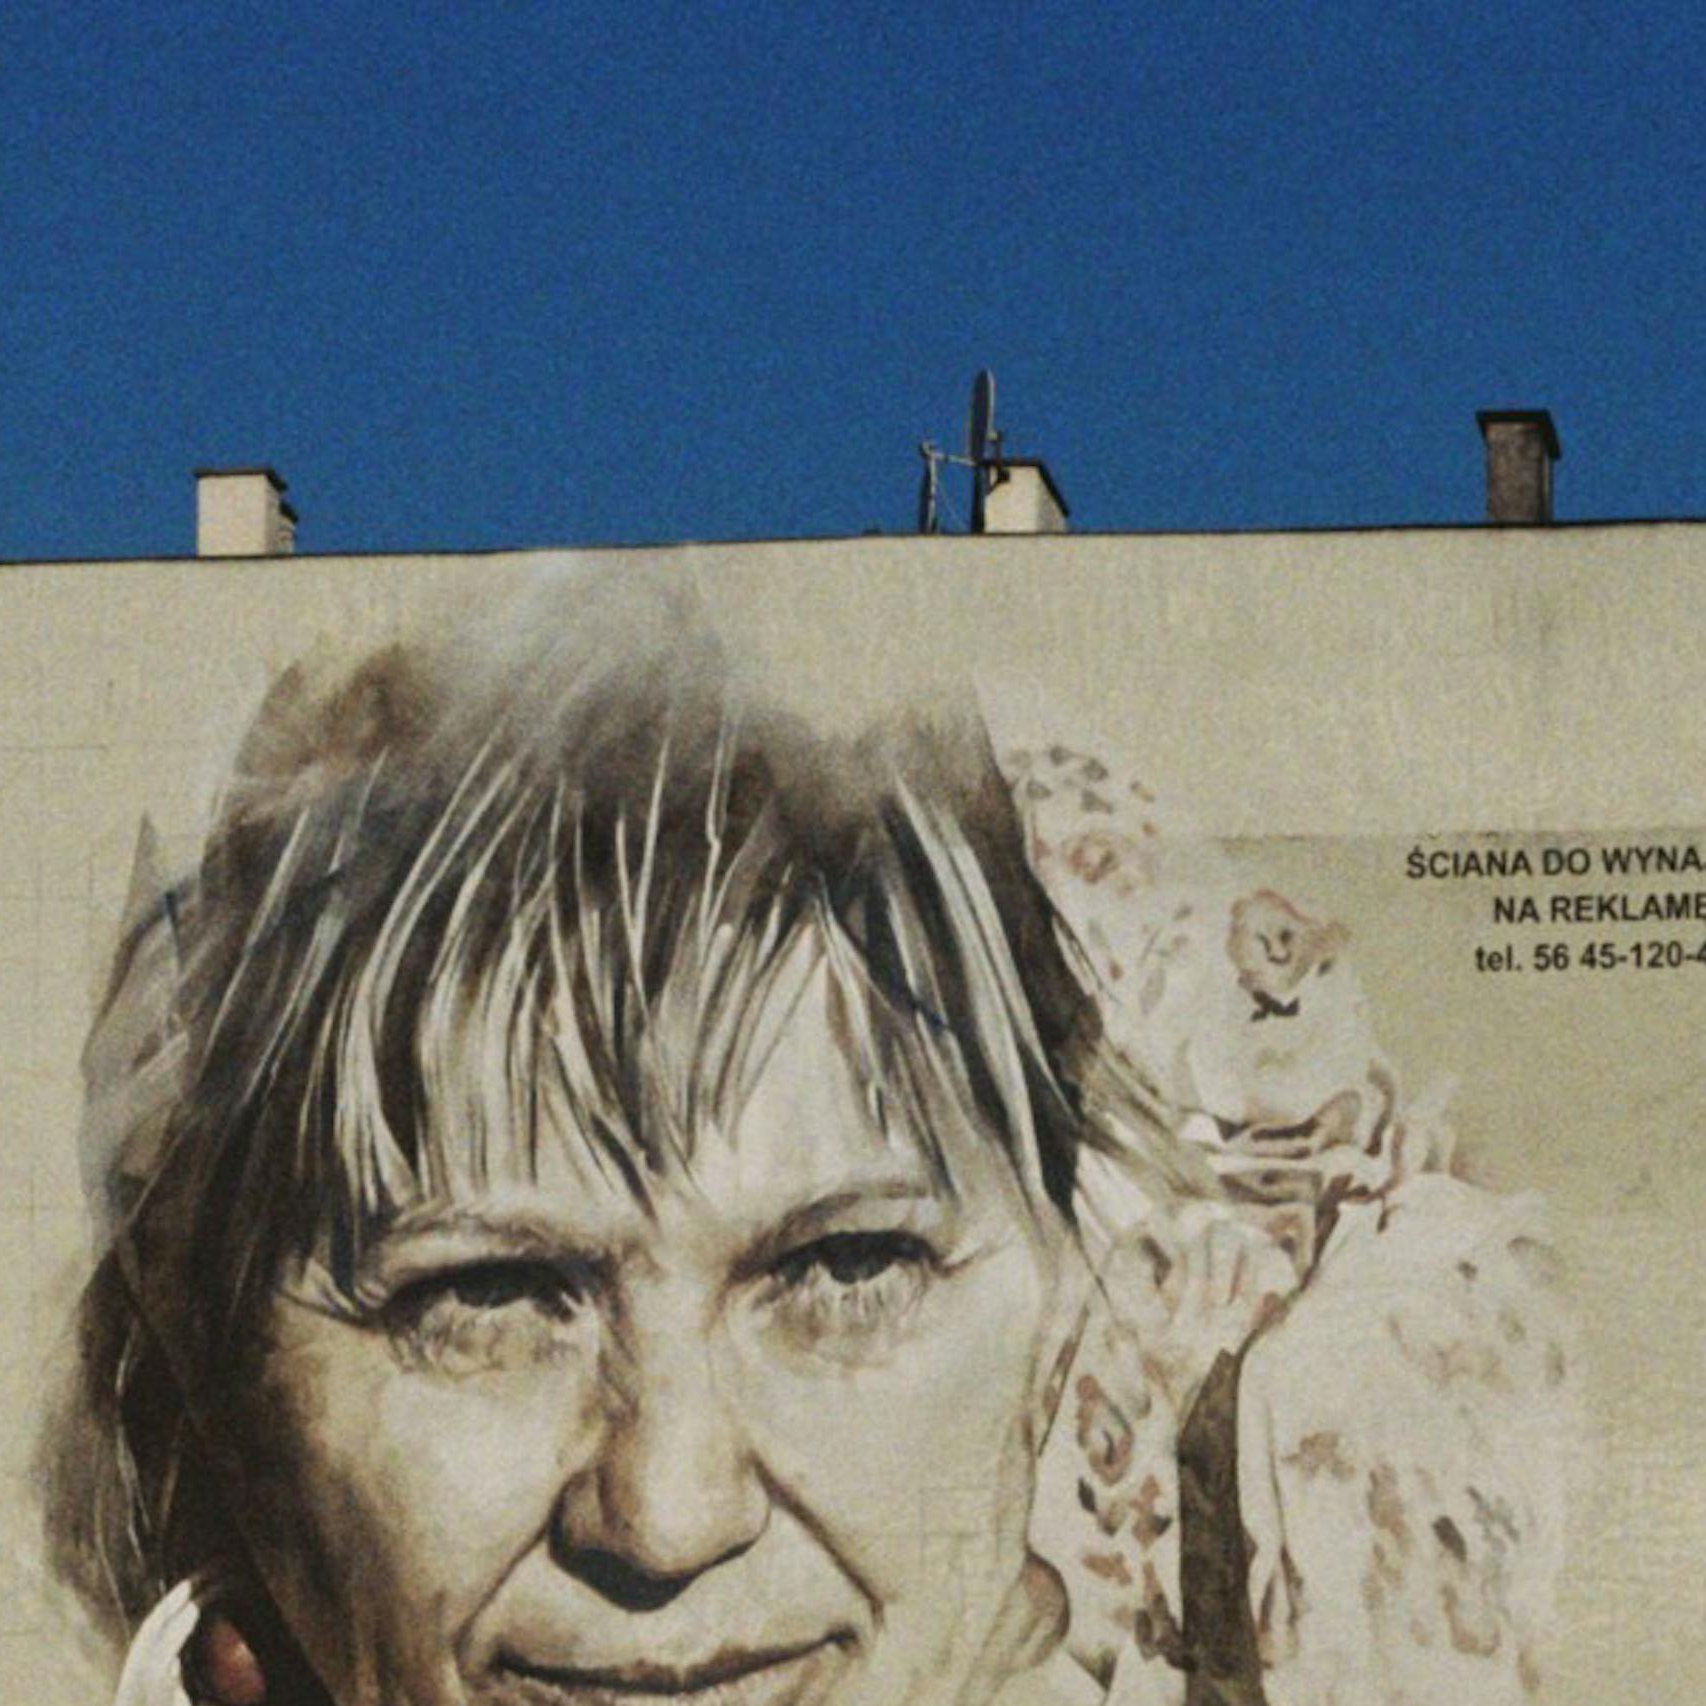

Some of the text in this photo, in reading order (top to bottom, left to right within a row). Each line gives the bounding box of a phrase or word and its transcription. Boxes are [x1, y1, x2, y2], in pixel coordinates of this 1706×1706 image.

[1405, 845, 1533, 879] ŚCIANA
[1543, 847, 1591, 876] DO
[1492, 896, 1540, 924] NA
[1475, 943, 1523, 972] tel.
[1532, 942, 1570, 971] 56
